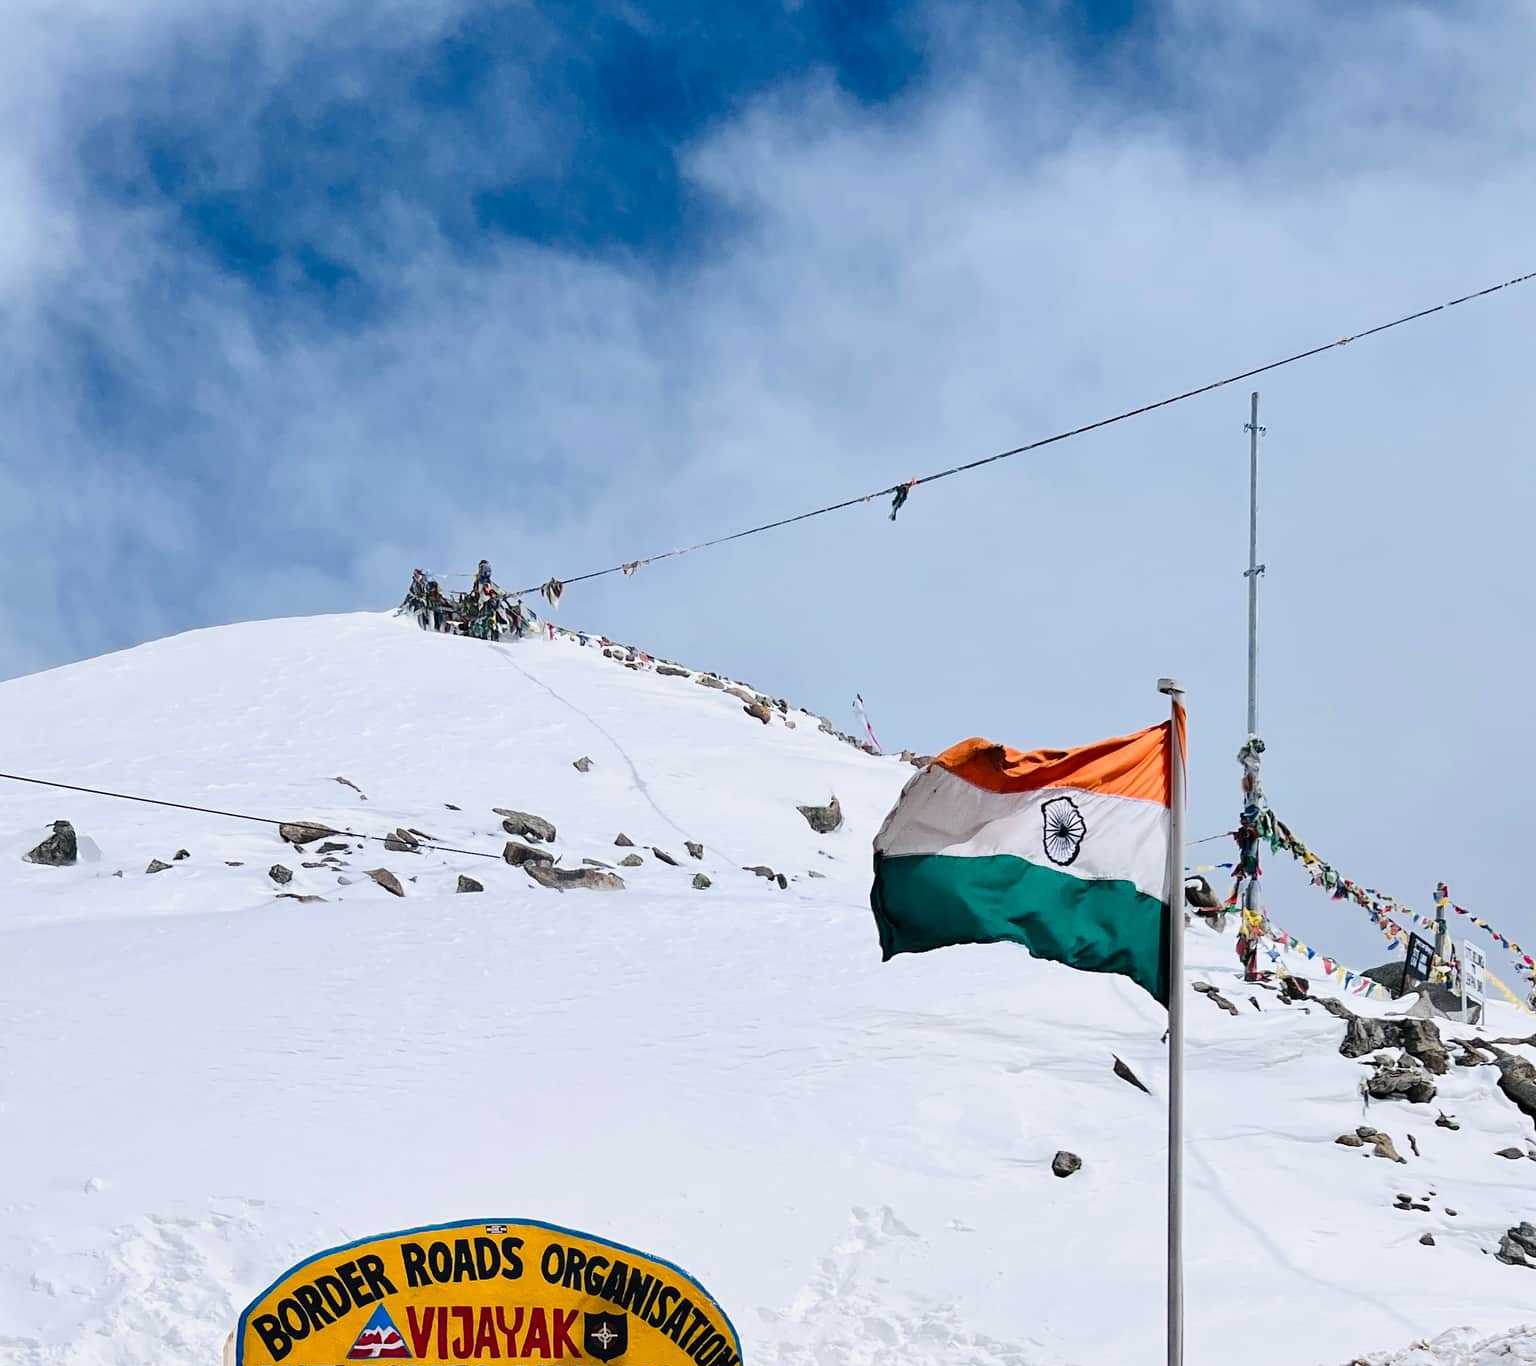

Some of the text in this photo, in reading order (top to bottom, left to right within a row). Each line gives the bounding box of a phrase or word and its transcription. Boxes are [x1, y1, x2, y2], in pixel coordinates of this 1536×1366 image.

[252, 1254, 399, 1362] BORDER
[401, 1237, 525, 1288] ROADS
[406, 1306, 583, 1360] VIJAYAK
